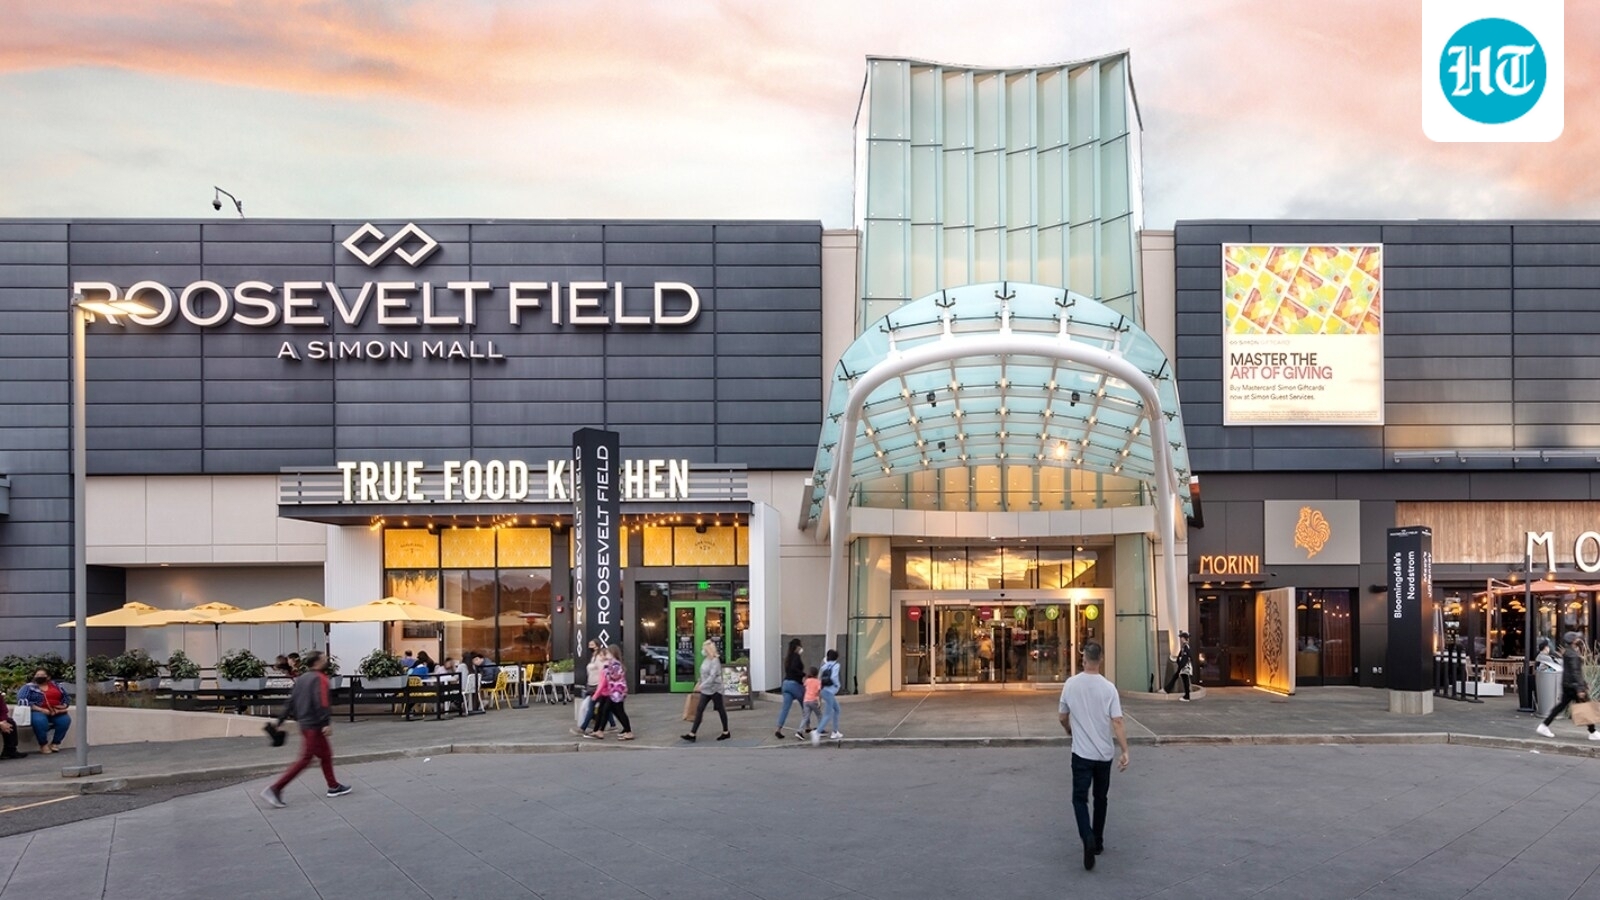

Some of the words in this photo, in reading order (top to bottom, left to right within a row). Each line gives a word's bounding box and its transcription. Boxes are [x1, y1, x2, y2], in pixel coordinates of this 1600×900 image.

[73, 280, 491, 326] ROOSEVELT
[509, 281, 700, 325] FIELD
[277, 341, 297, 359] A
[307, 341, 409, 359] SIMON
[422, 341, 504, 359] MALL
[1230, 352, 1288, 366] MASTER
[1290, 352, 1317, 366] THE
[1229, 384, 1241, 393] Buy
[1230, 366, 1258, 379] ART
[1261, 366, 1280, 379] OF
[1283, 366, 1333, 379] GIVING
[337, 461, 425, 501] TRUE
[444, 460, 529, 500] FOOD
[547, 459, 689, 499] KIHEN
[597, 445, 609, 502] FIELD
[597, 505, 610, 625] ROOSEVELT
[1200, 555, 1259, 575] MORINI
[1394, 552, 1404, 618] Bloomingdale's
[1407, 550, 1415, 600] Nordstrom
